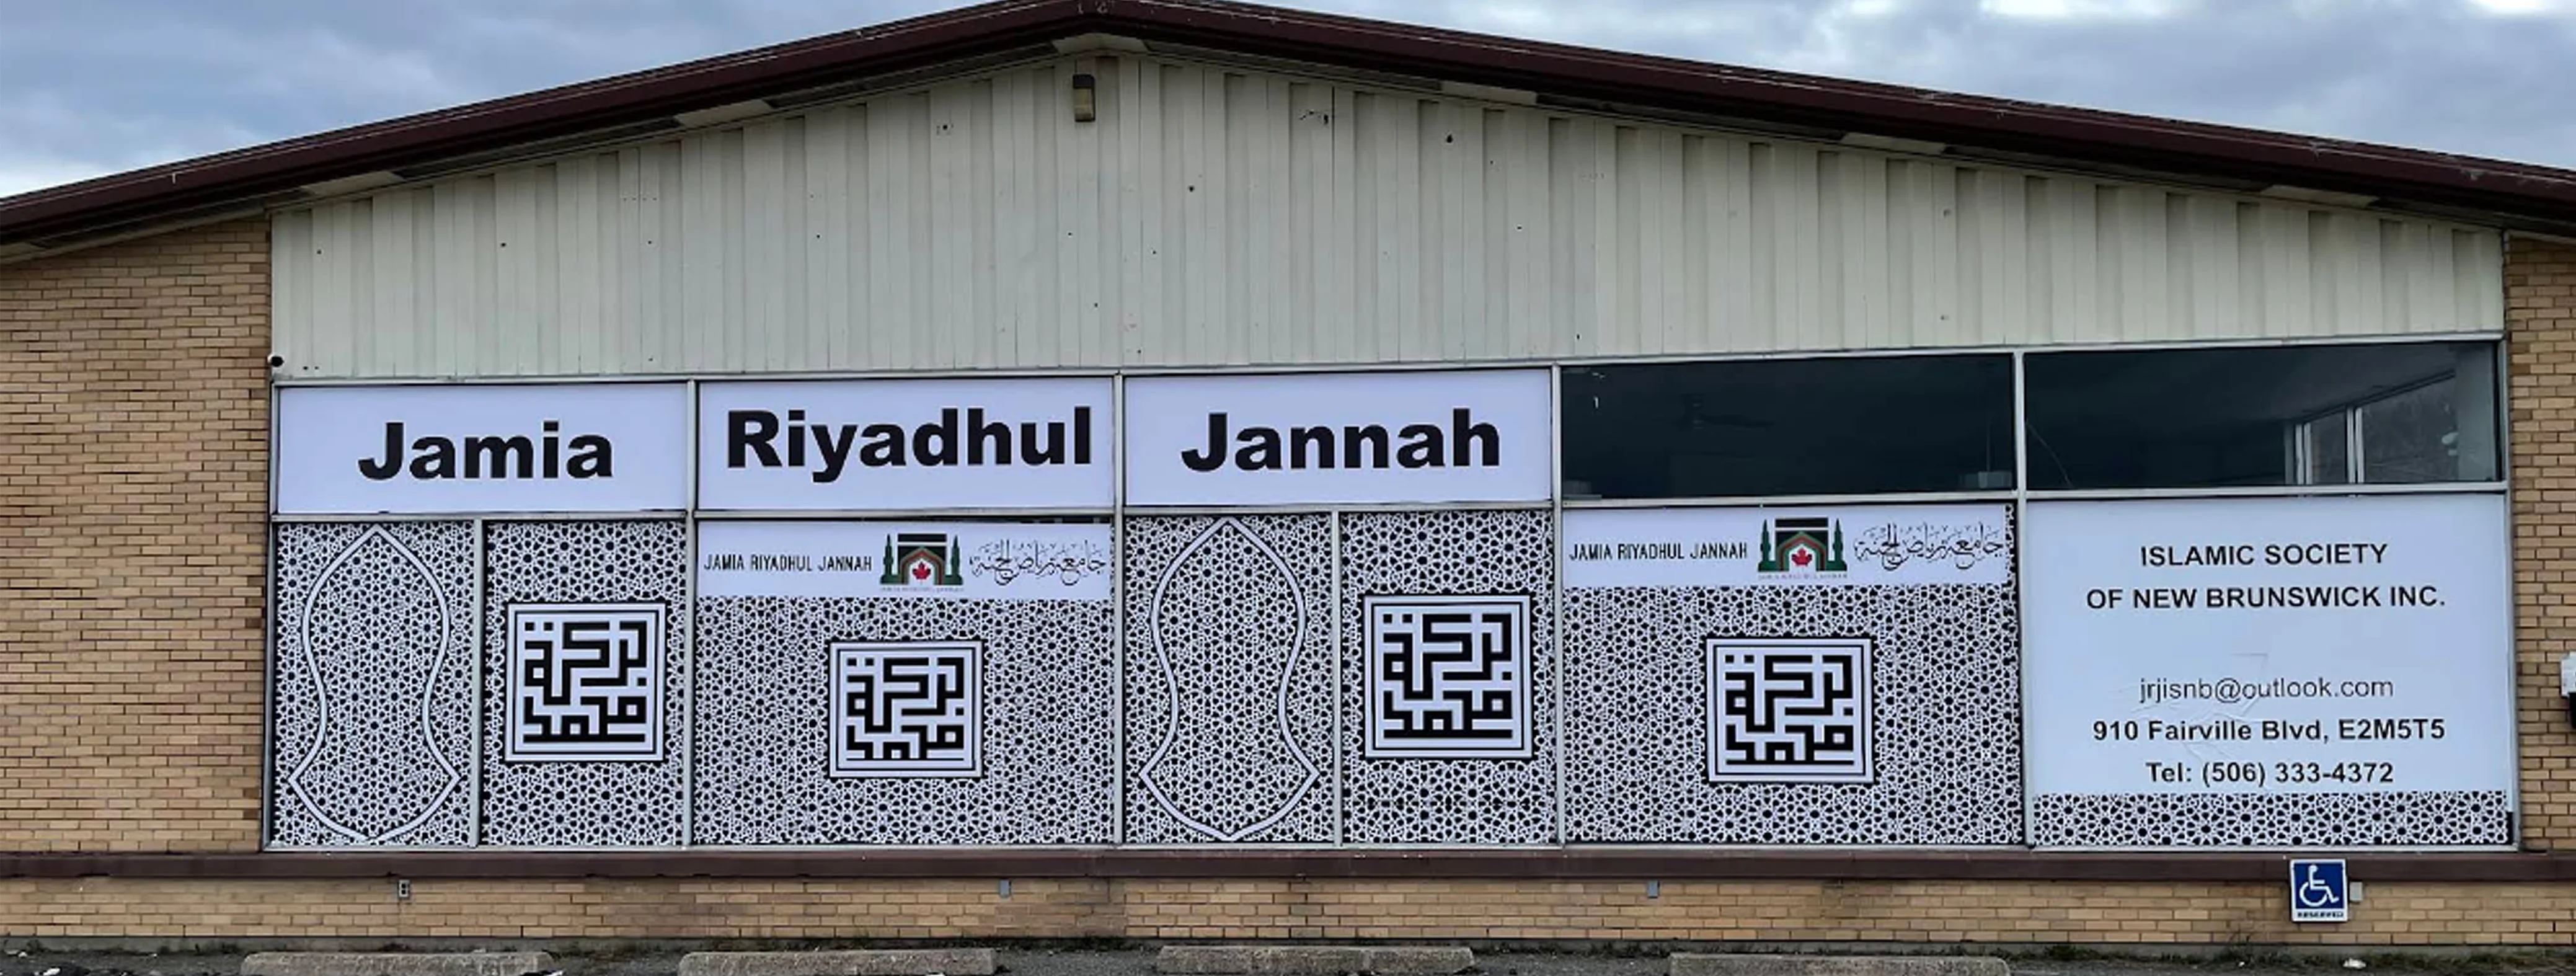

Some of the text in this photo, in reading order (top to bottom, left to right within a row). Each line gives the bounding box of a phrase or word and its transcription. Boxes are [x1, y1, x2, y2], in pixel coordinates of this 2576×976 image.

[358, 407, 1499, 483] Jamia Riyadhul Jannah
[704, 554, 872, 572] JAMIA RIYADHUL JANNAH
[1569, 541, 1747, 561] JAMIA RIYADHUL JANNAH
[2141, 543, 2388, 567] ISLAMIC SOCIETY
[2087, 585, 2445, 609] OF NEW BRUNSWICK INC.
[2140, 678, 2393, 704] jrjisnb@outlook.com
[2093, 719, 2445, 743] 910 Fairville Blvd, E2M5T5
[2146, 761, 2393, 788] Tel: (506) 333-4372
